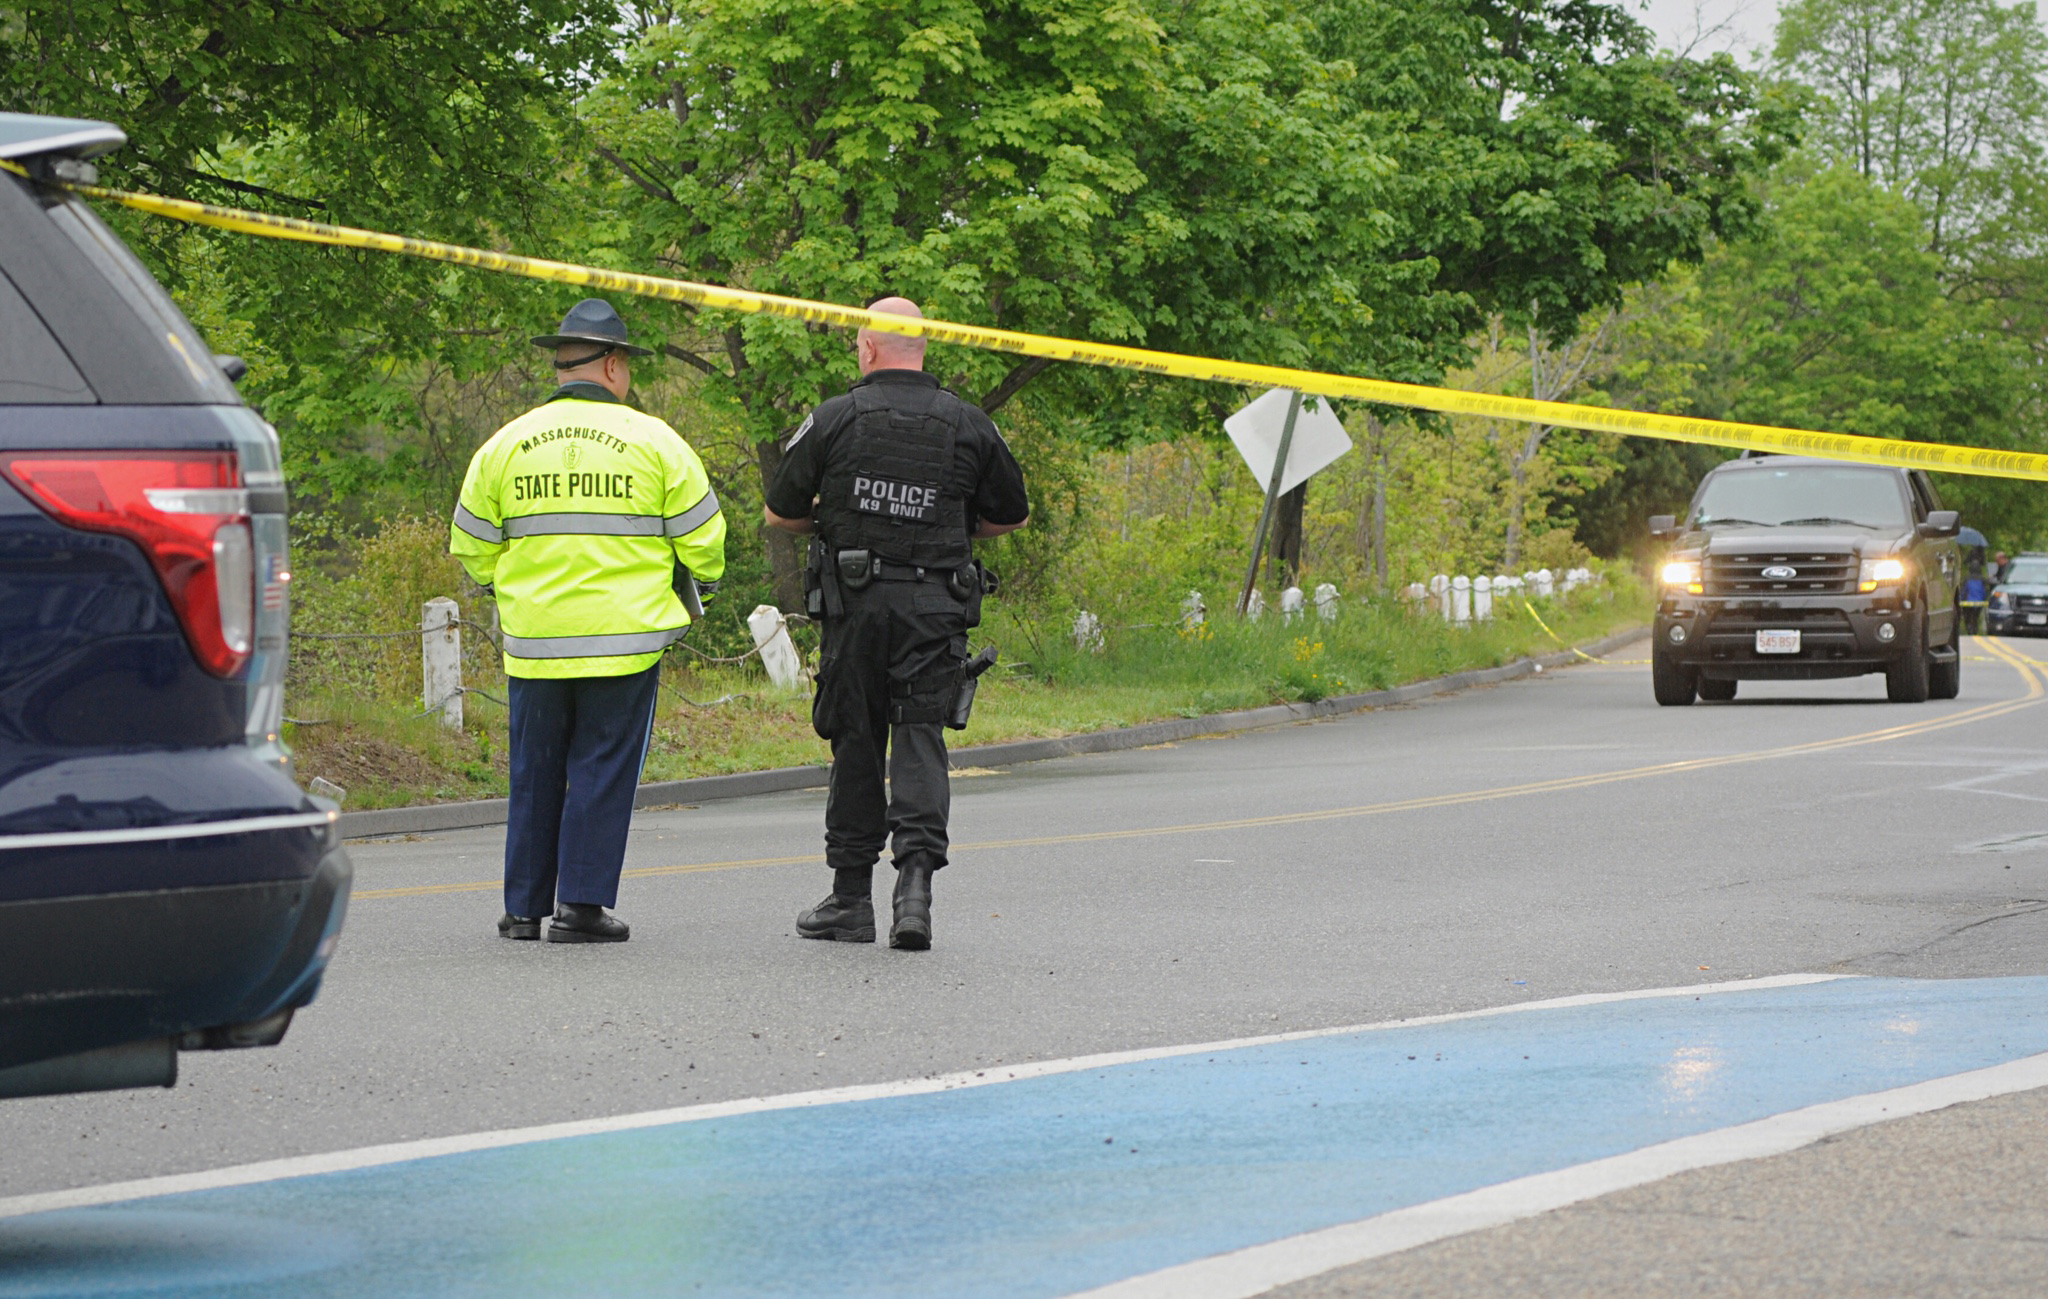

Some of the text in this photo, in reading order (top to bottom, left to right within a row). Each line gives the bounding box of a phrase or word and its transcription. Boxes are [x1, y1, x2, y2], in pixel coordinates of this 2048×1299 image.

[521, 426, 628, 454] MASSACHUSETTS
[514, 473, 633, 501] STATE POLICE
[854, 477, 937, 507] POLICE
[860, 498, 925, 518] K9 UNIT
[1759, 636, 1777, 648] 545
